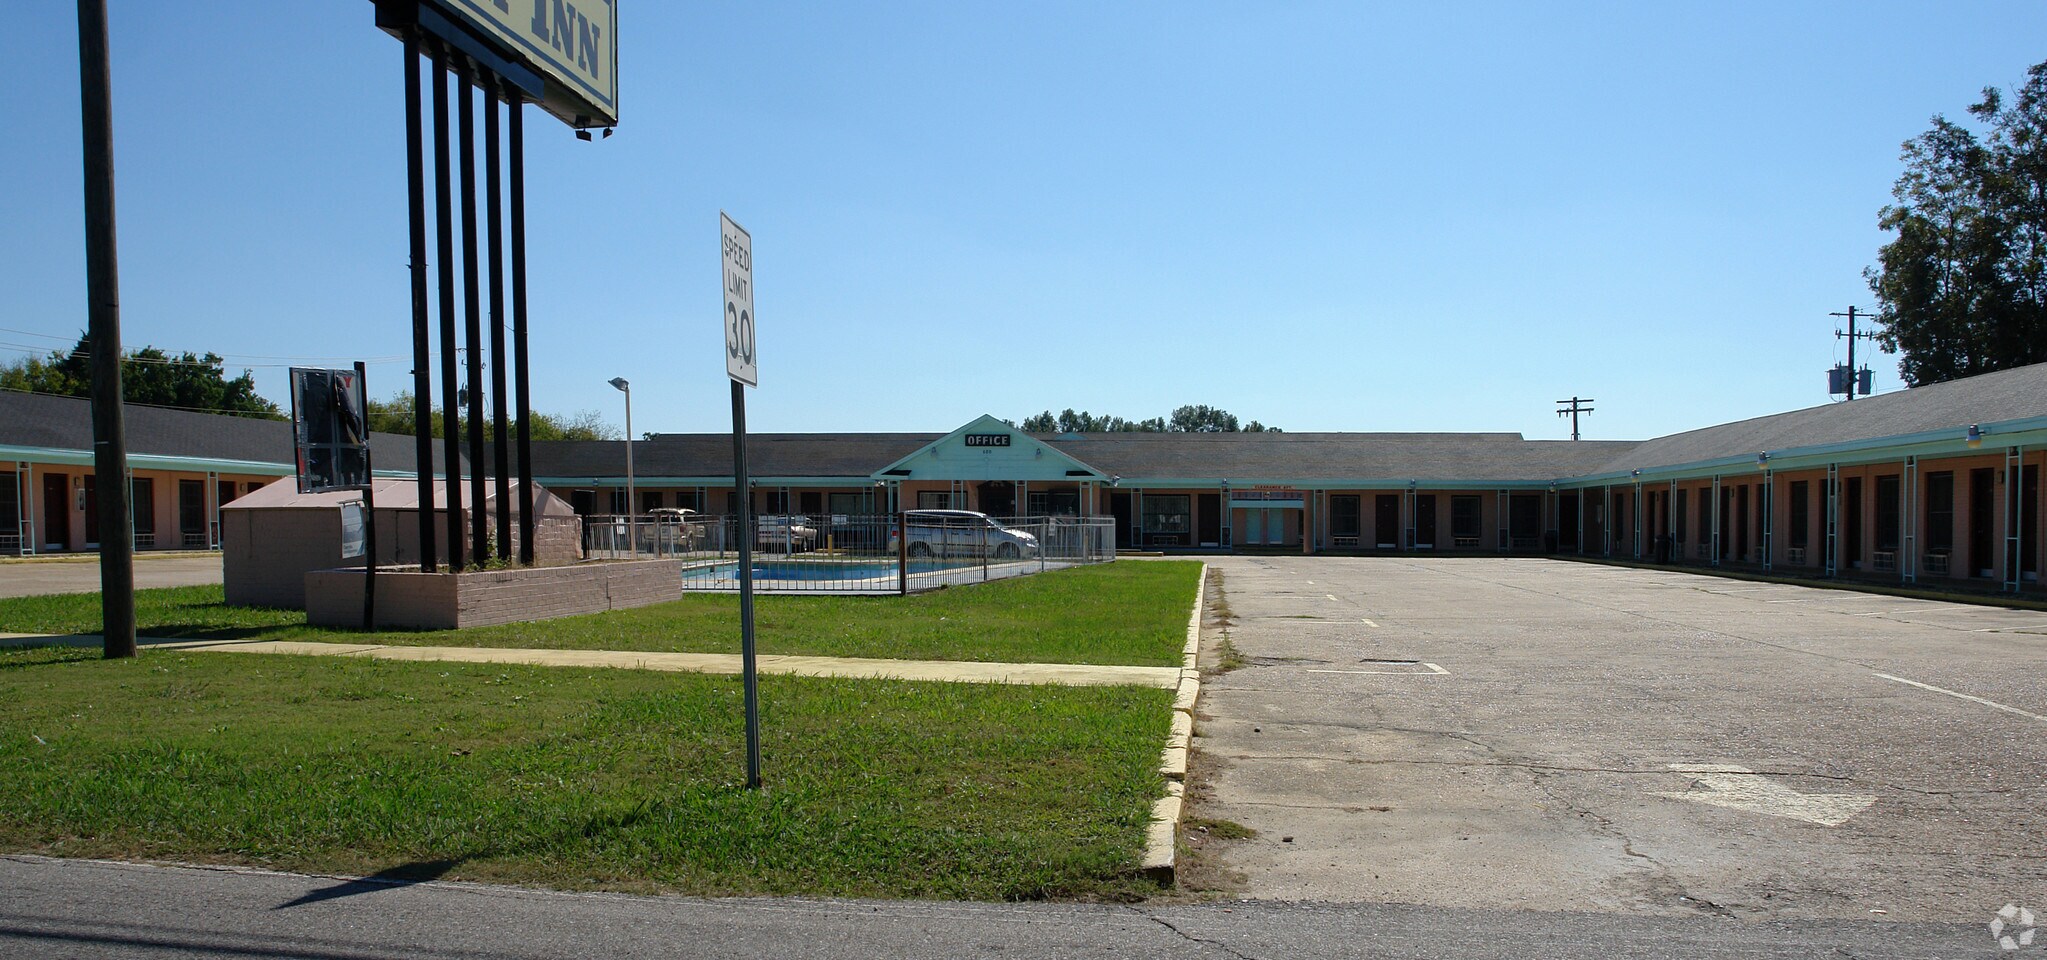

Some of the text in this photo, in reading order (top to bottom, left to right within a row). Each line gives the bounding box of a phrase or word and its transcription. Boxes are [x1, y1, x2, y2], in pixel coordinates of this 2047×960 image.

[531, 0, 600, 80] INN
[723, 233, 750, 273] SPEED
[727, 268, 748, 302] LIMIT
[727, 301, 752, 365] 30
[967, 435, 1008, 446] OFFICE
